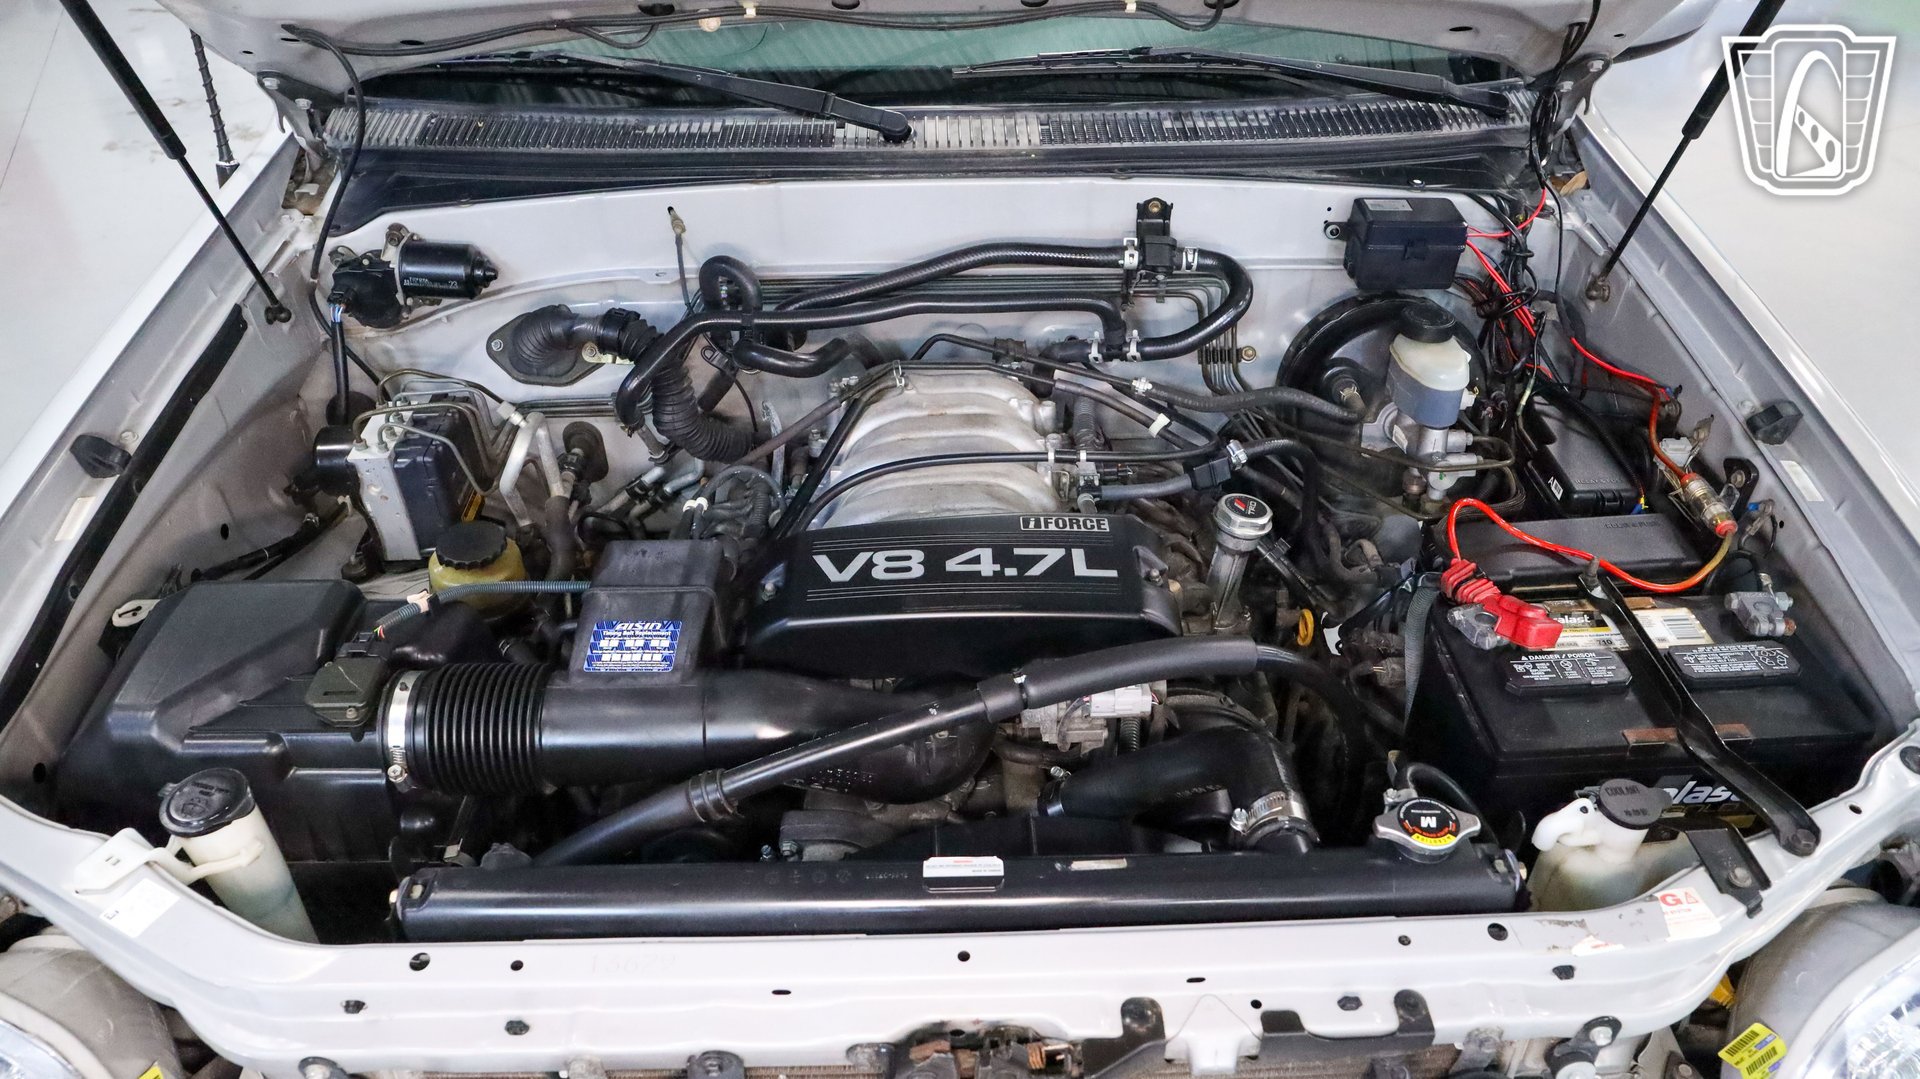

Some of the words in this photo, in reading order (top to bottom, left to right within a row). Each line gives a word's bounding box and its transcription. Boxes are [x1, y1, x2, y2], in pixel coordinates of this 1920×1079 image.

[1248, 501, 1257, 515] TRD
[812, 550, 925, 583] V8
[945, 547, 1119, 578] 4.7L
[1528, 653, 1560, 661] DANGER
[1567, 652, 1596, 660] POISON
[1604, 785, 1641, 797] COOLANT
[1660, 893, 1683, 907] G
